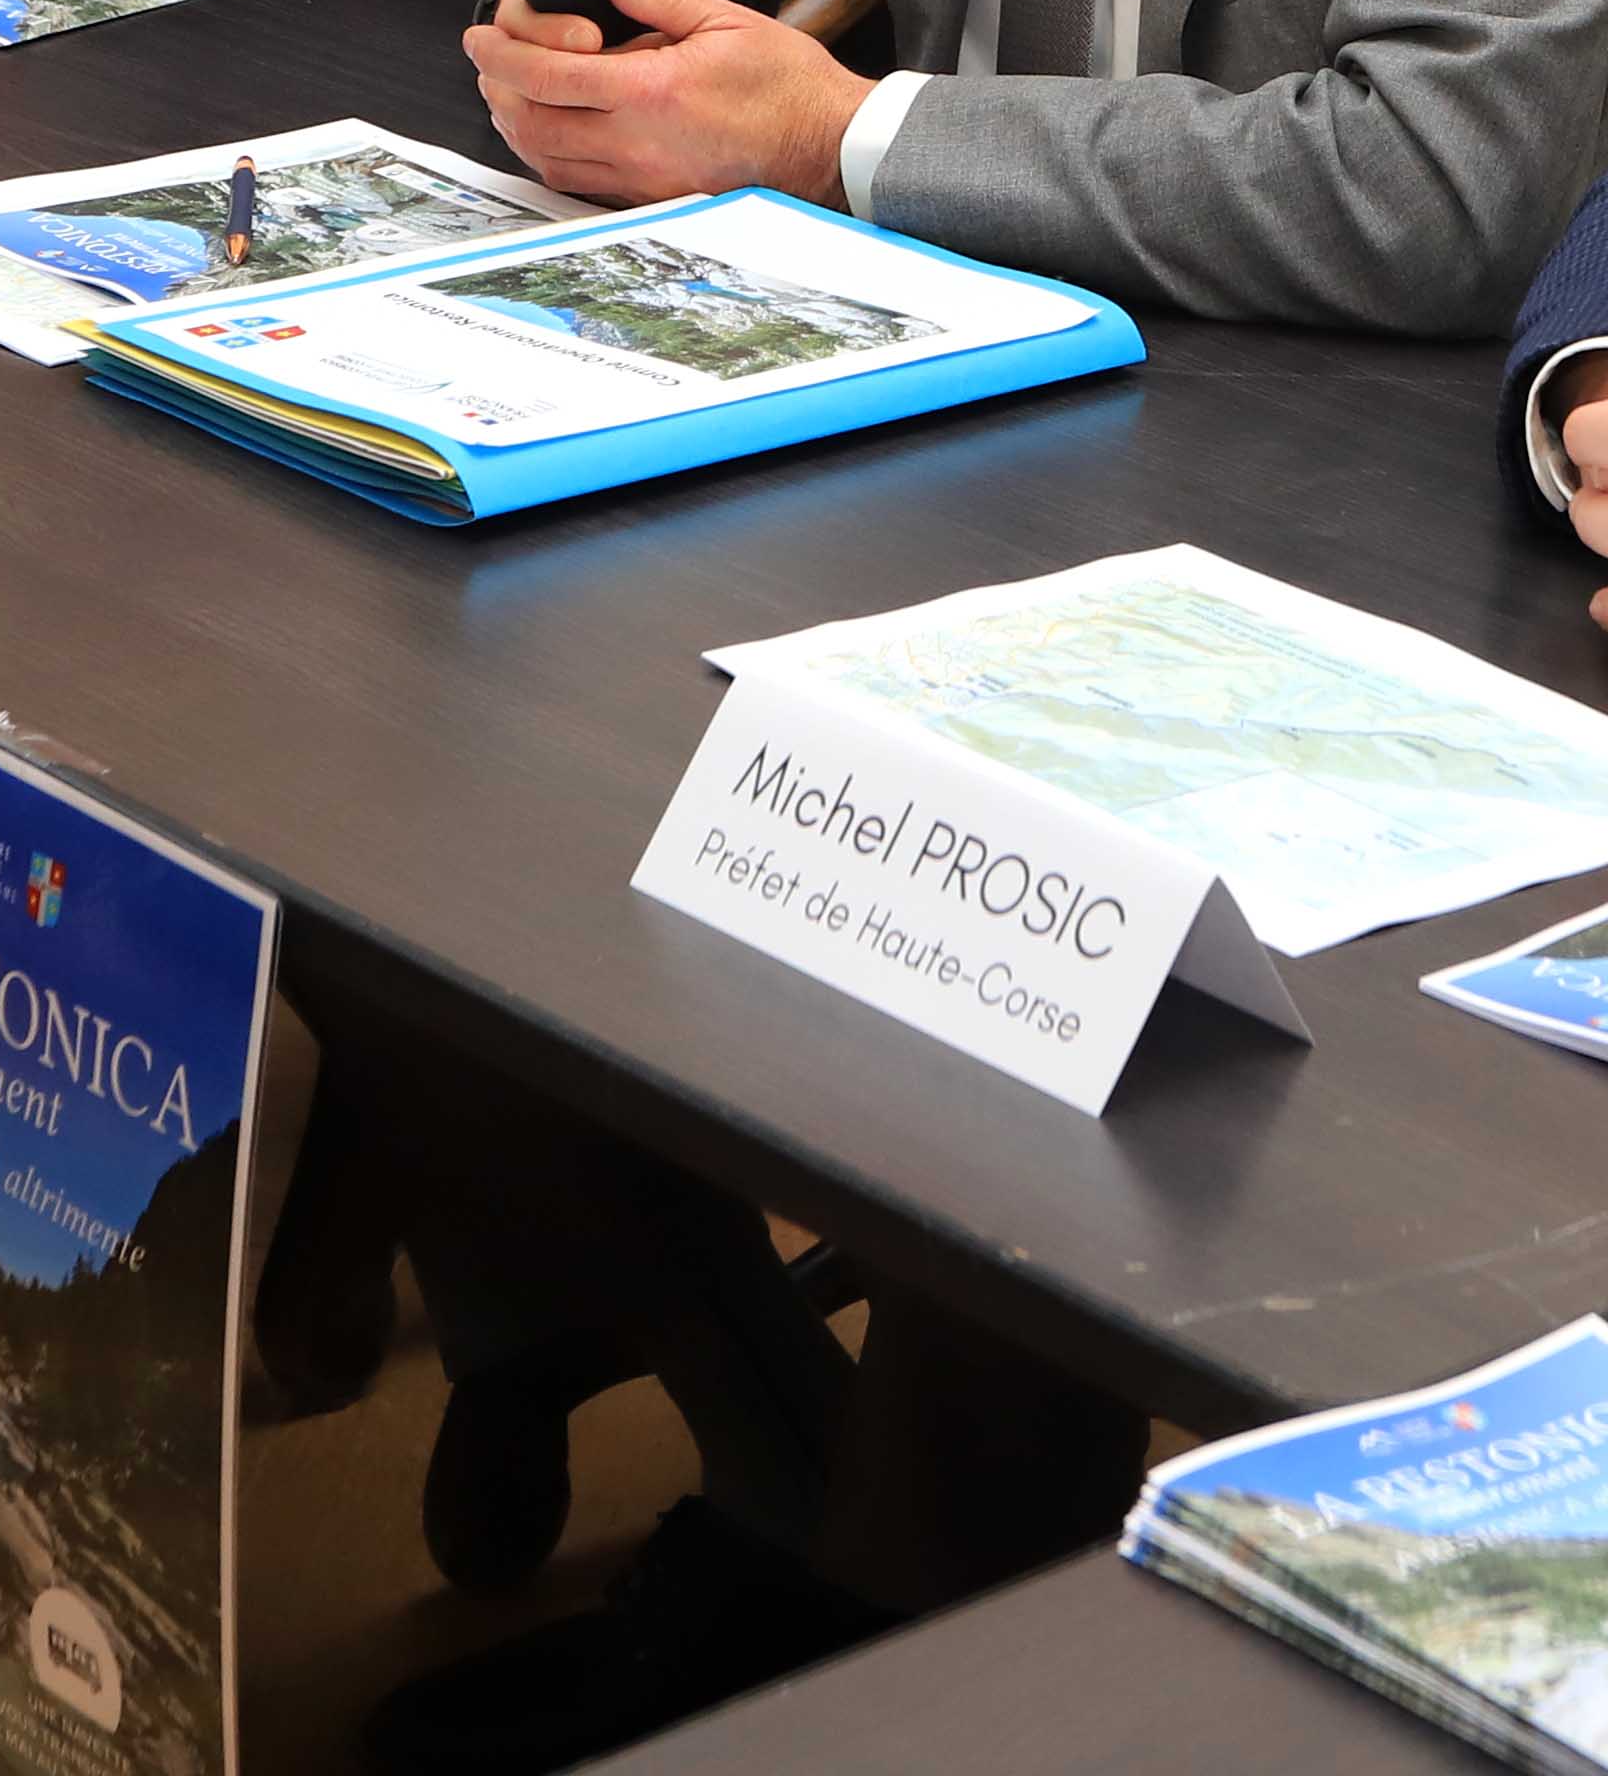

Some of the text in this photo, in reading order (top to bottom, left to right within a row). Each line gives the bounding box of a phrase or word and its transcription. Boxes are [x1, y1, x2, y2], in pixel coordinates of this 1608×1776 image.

[383, 291, 471, 327] Restonica
[731, 740, 1127, 960] Michel PROSIC
[694, 826, 1082, 1042] Préfet de Haute-Corse
[2, 1165, 148, 1273] altrimente
